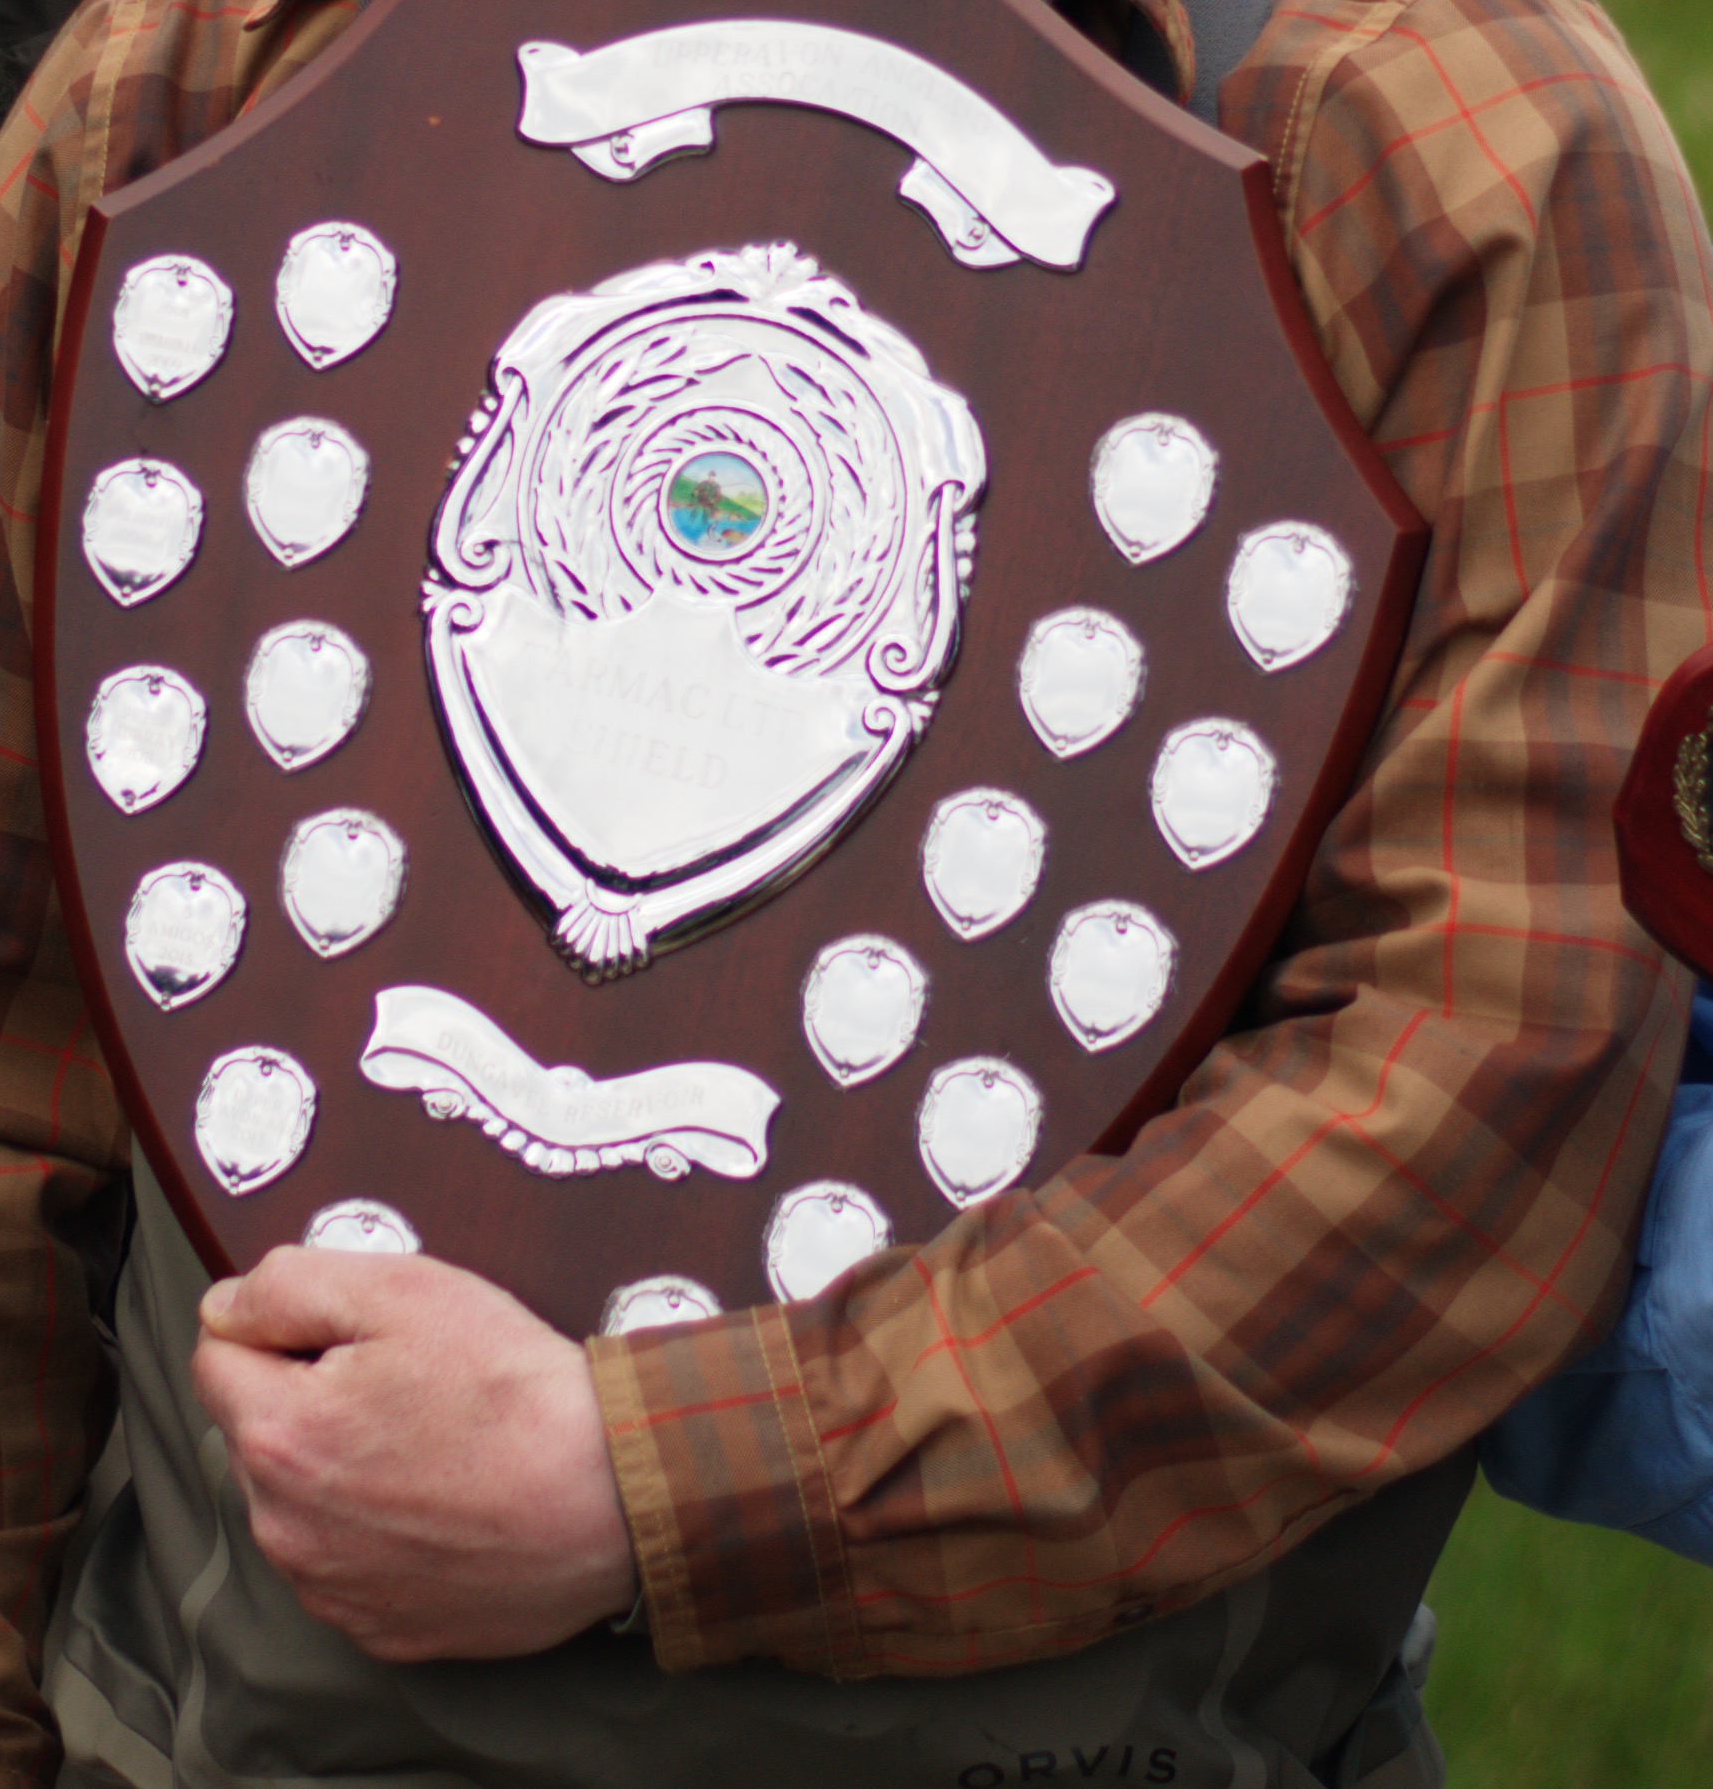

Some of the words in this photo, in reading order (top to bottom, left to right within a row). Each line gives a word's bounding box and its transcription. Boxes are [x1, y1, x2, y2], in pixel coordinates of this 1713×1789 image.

[522, 640, 711, 720] TARMAC
[563, 718, 729, 790] SHIELD
[436, 1031, 550, 1117] DUNGAVEL
[563, 1083, 706, 1124] RESERVOIR
[958, 1744, 1178, 1789] ORVIS
